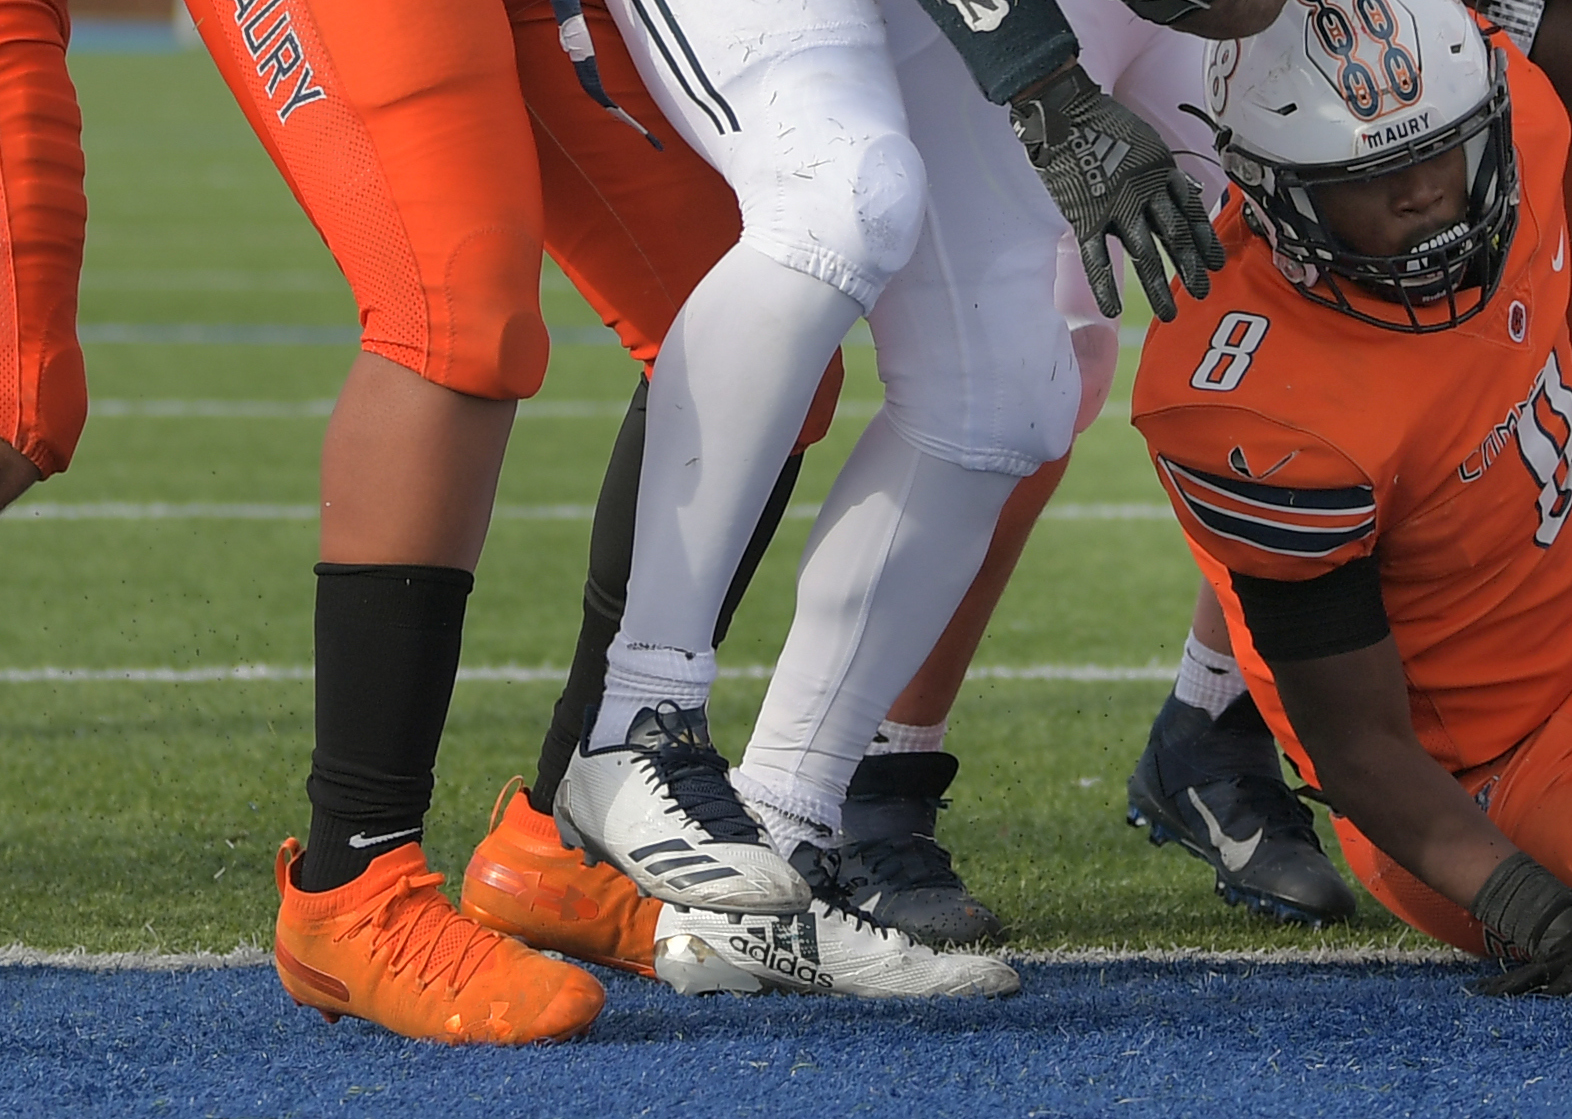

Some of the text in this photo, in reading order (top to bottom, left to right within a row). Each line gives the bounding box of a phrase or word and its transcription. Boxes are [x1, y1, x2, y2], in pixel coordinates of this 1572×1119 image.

[1367, 112, 1430, 149] MAURY
[1189, 310, 1271, 392] 8
[729, 935, 834, 988] adidas
